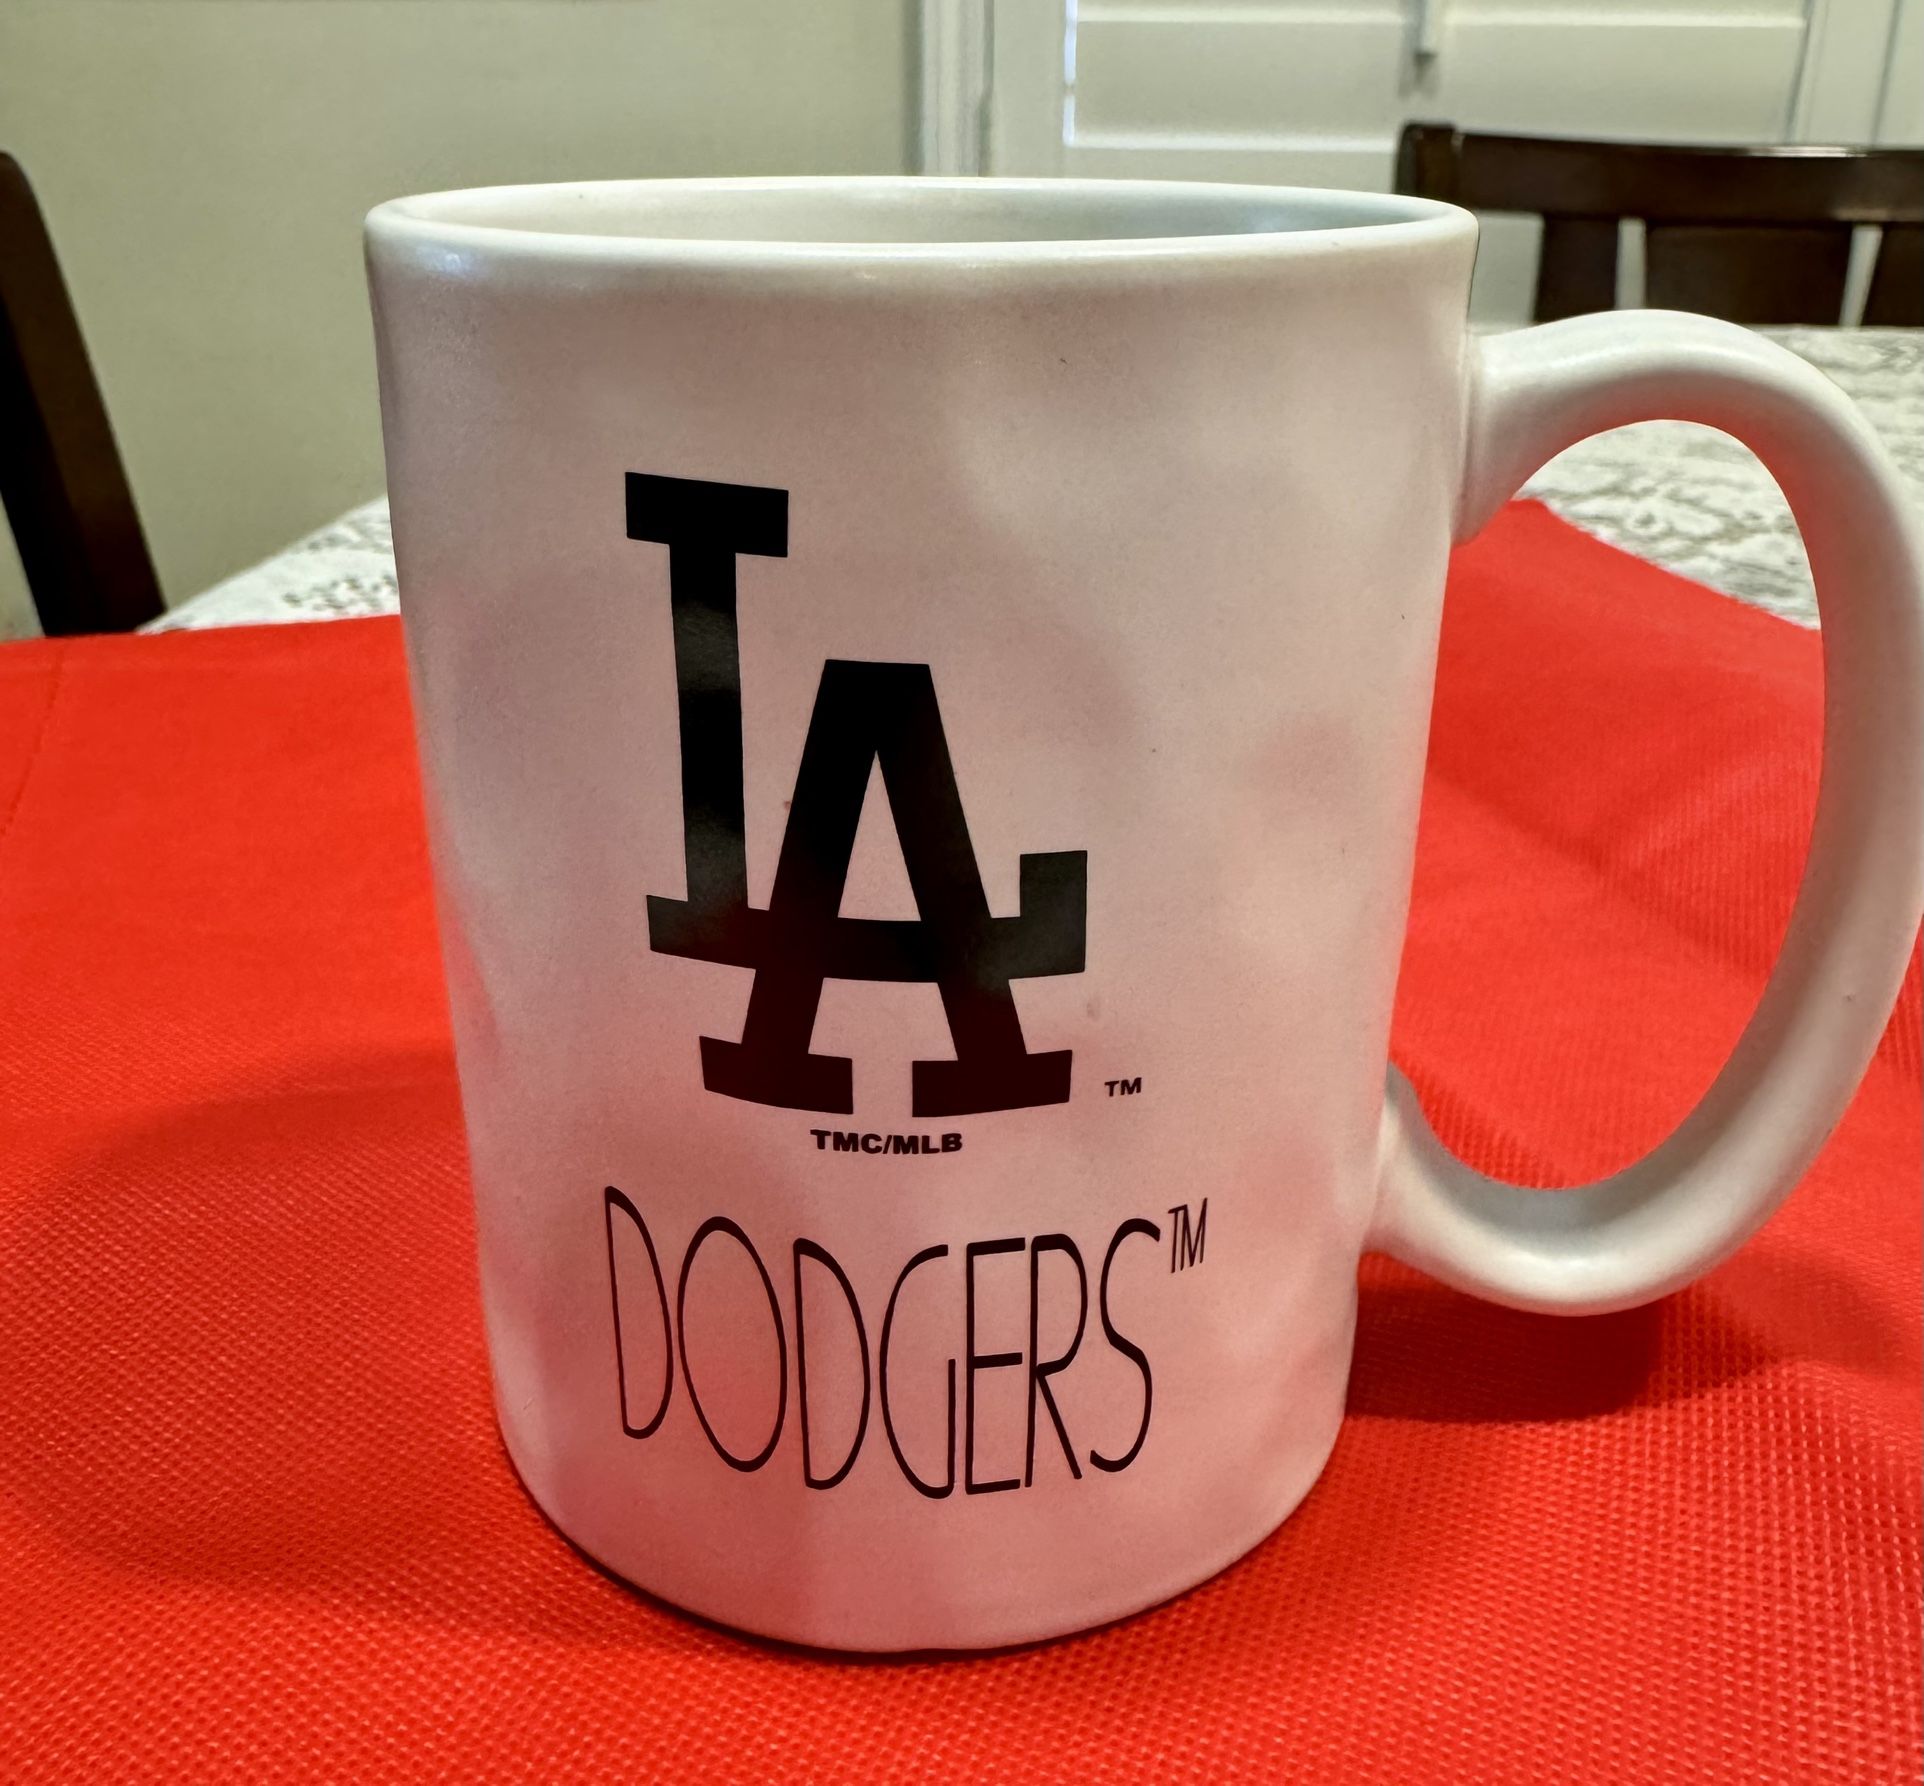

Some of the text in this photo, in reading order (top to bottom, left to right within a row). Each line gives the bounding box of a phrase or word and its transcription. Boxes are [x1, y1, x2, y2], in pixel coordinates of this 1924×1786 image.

[625, 472, 1088, 1118] LA
[809, 1128, 963, 1155] TMC/MLB
[1103, 1076, 1143, 1098] TM
[603, 1185, 1161, 1500] DODGERS
